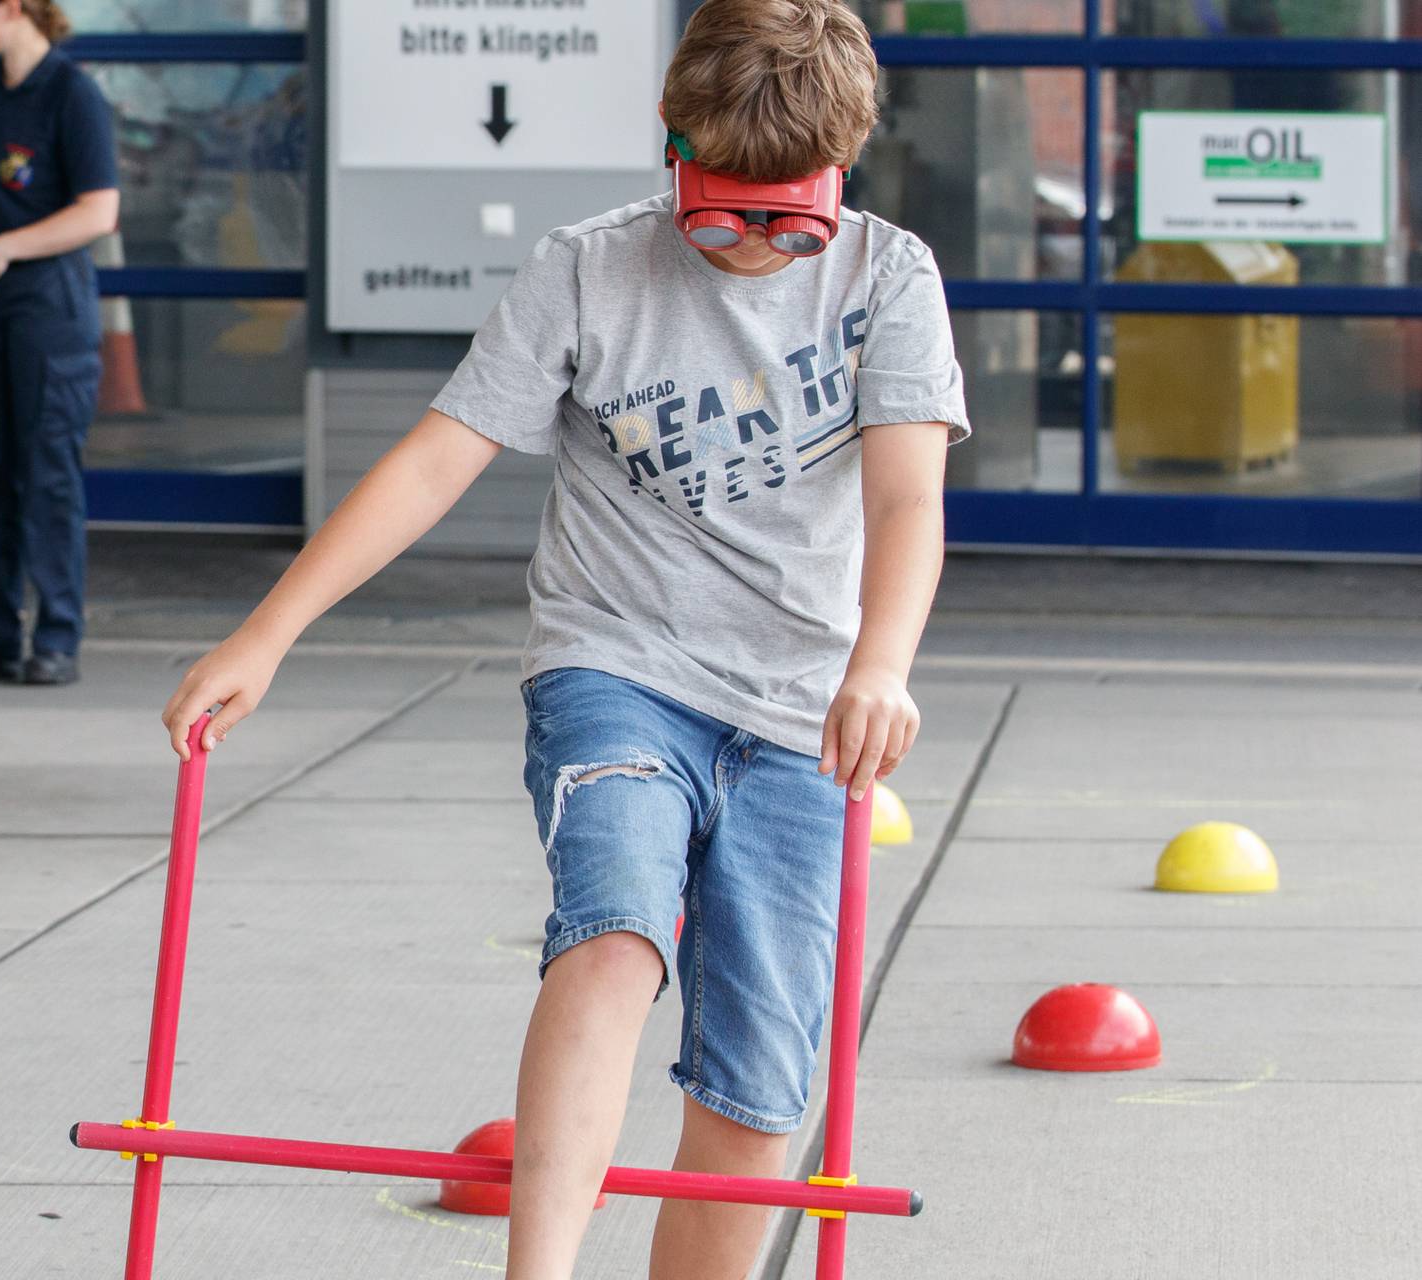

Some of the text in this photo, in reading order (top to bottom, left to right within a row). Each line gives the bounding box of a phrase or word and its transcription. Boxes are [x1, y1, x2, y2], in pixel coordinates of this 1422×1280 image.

[400, 25, 598, 61] bitte klingeln
[626, 380, 676, 410] AHEAD
